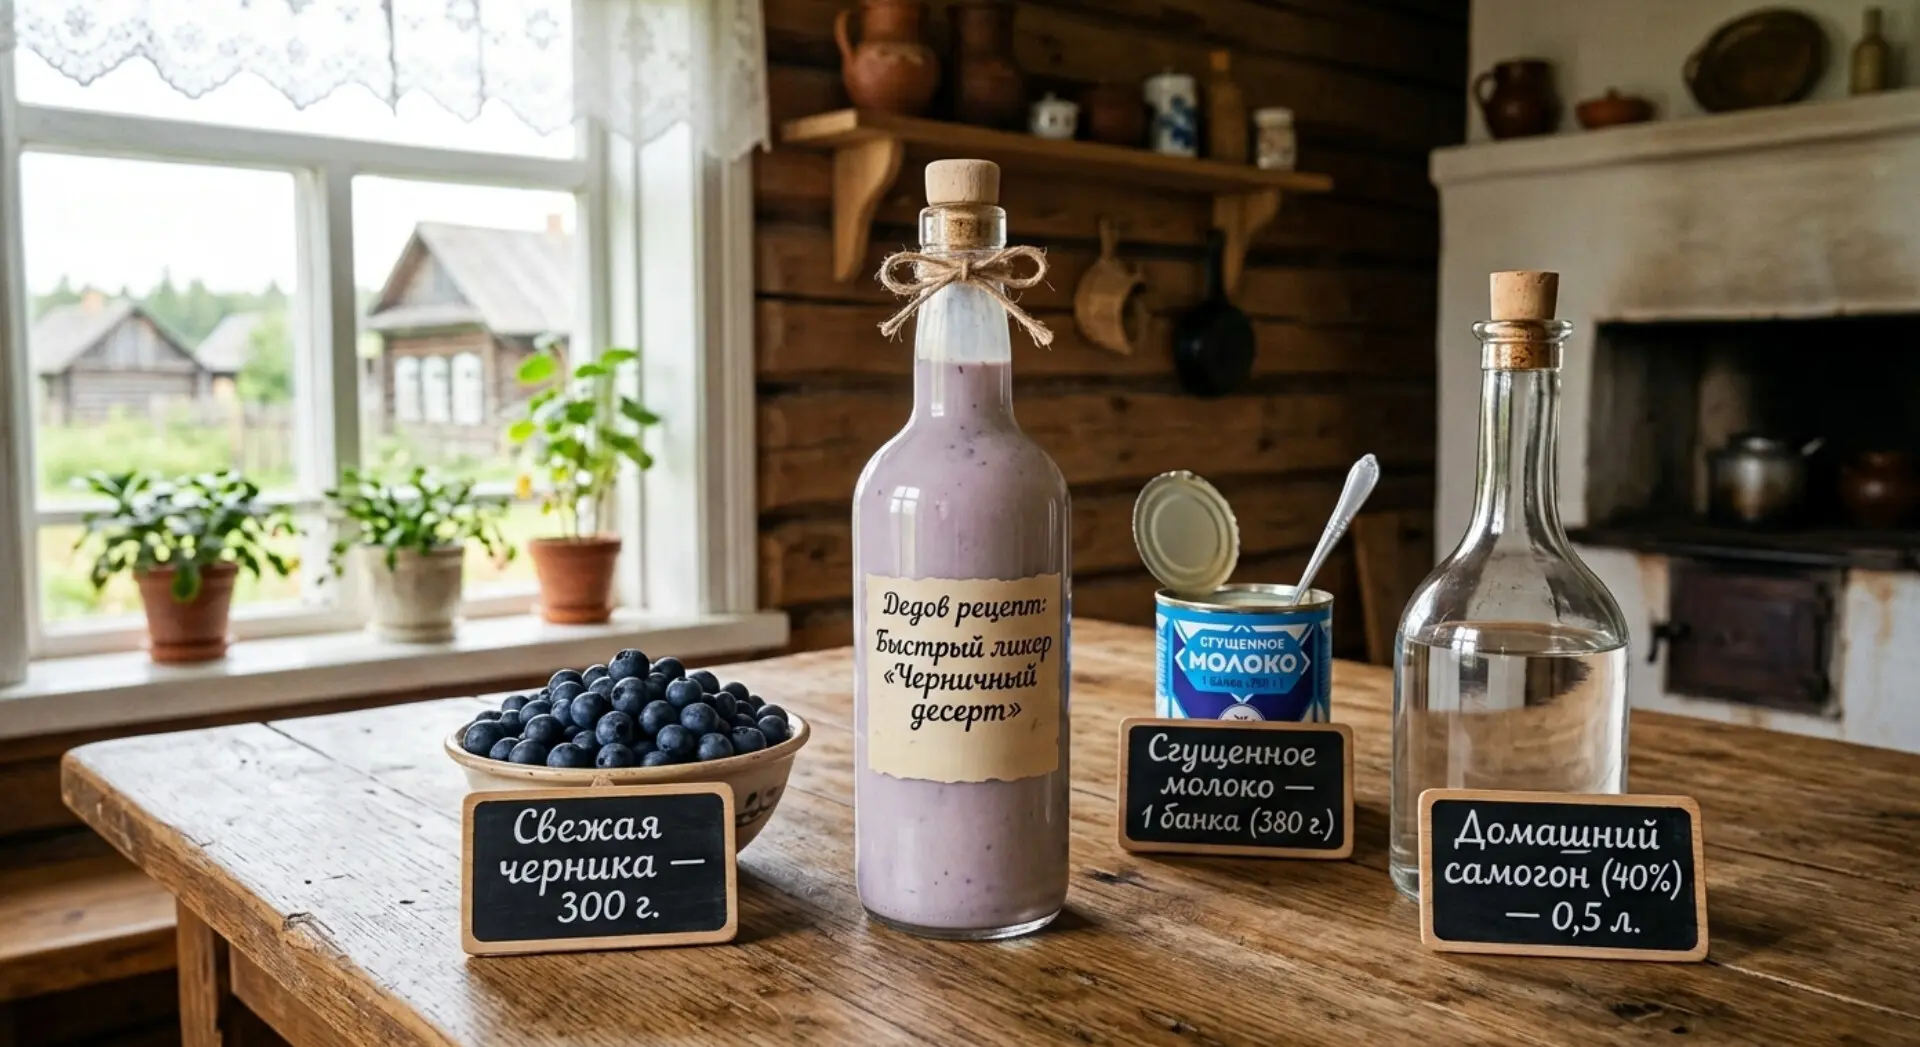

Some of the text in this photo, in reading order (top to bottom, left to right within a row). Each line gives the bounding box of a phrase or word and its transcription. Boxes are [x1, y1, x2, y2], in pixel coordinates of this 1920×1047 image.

[882, 591, 1047, 628] Дедов рецепт:
[875, 628, 1052, 666] Быстрый ликер
[1189, 650, 1297, 674] МОЛОКО
[883, 662, 1038, 699] «Черничный
[909, 702, 1022, 733] десерт»
[1148, 732, 1316, 773] Сгущенное
[1160, 776, 1274, 799] молоко
[513, 807, 663, 845] Свежая
[1142, 802, 1334, 841] 1 банка (380 г.)
[1453, 808, 1661, 854] Домашний
[499, 854, 658, 897] черника
[1444, 857, 1682, 901] самогон (40%)
[557, 889, 660, 924] 300 г.
[1551, 901, 1603, 937] 0,5
[1609, 911, 1641, 934] л.
